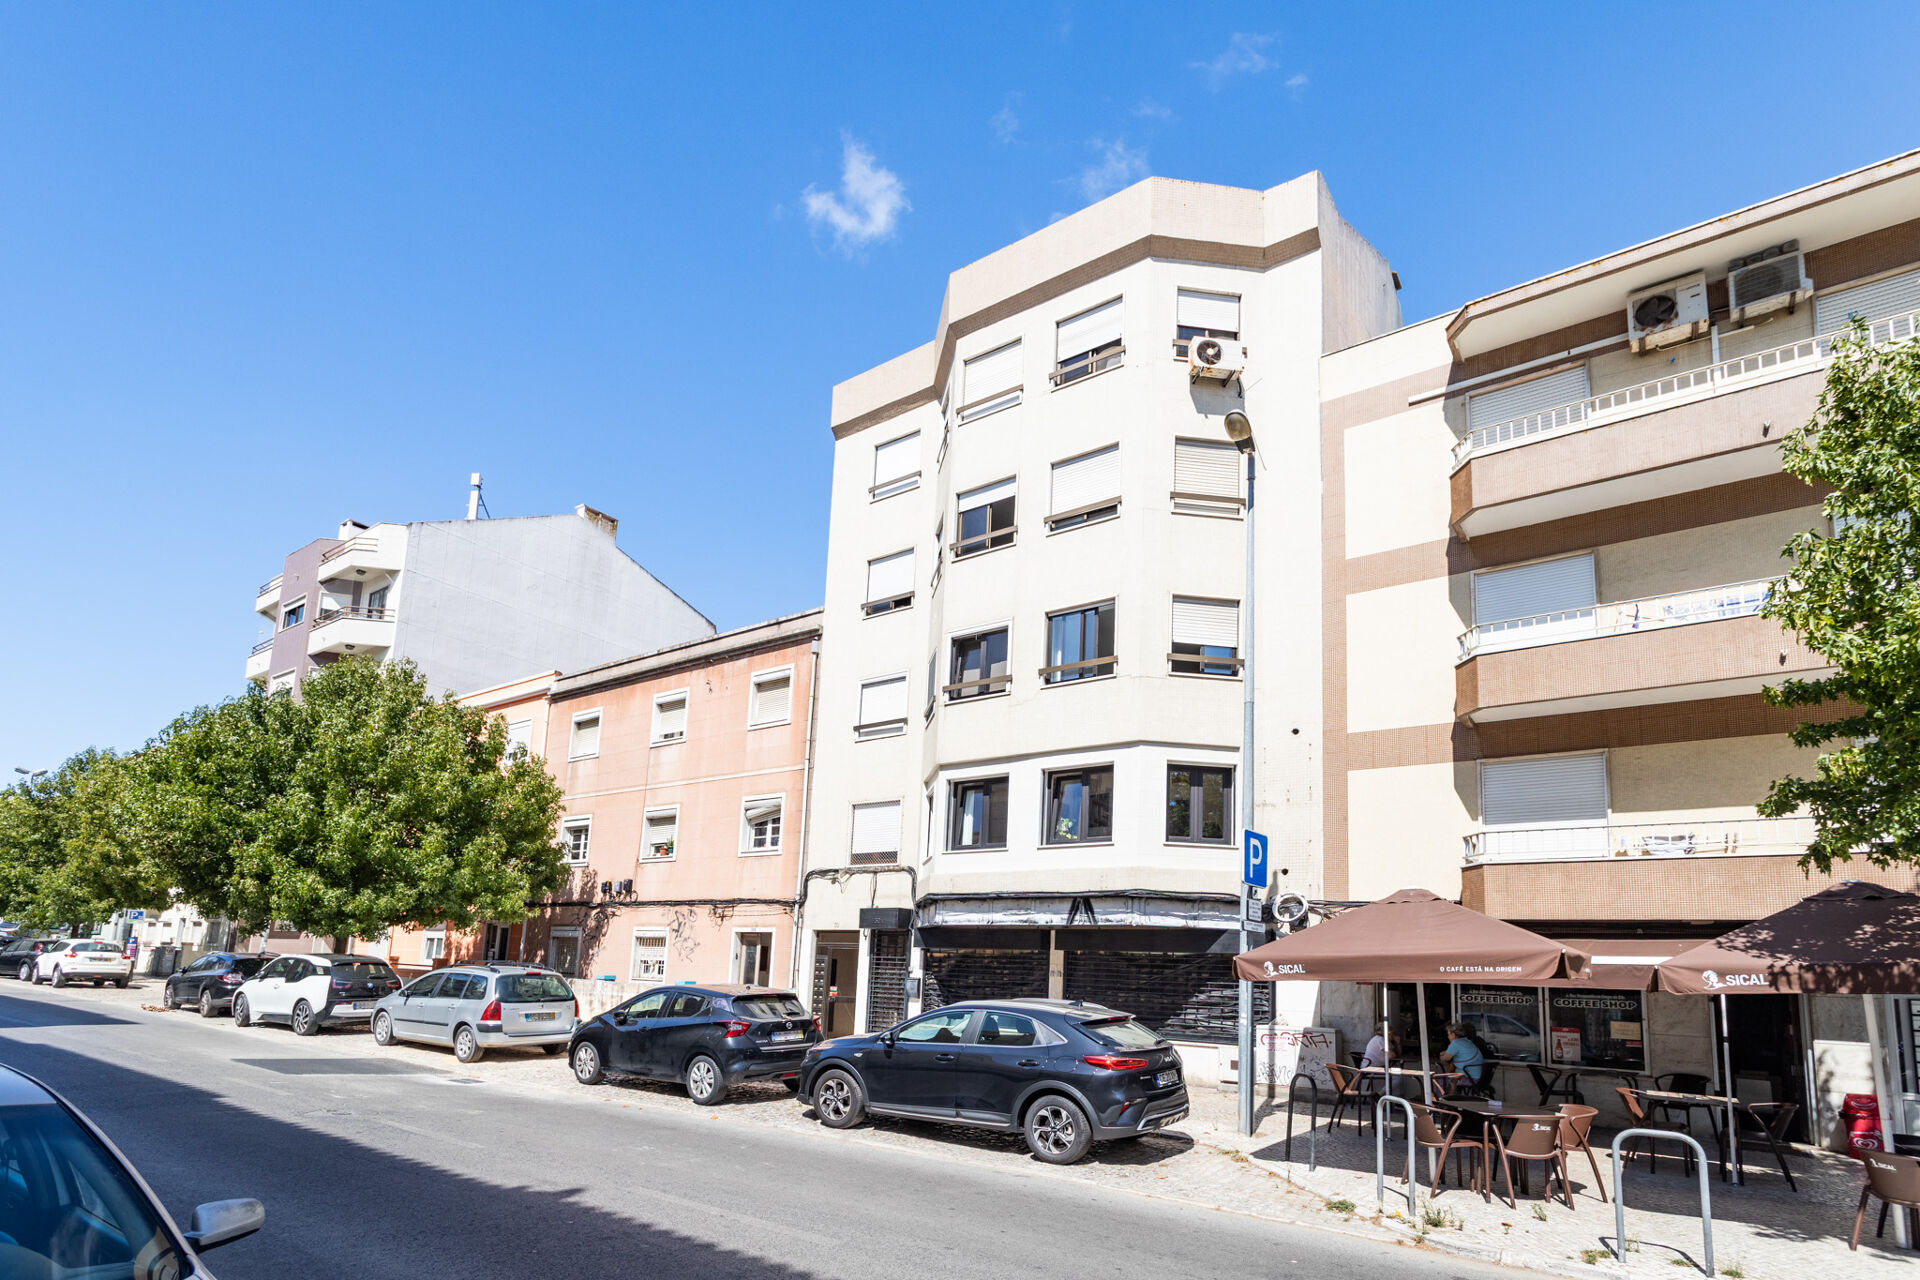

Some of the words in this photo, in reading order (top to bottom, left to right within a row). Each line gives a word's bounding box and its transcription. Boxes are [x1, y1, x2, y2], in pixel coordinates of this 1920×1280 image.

[1250, 837, 1262, 878] P
[1278, 964, 1306, 974] SICAL
[1446, 965, 1464, 973] CAFÉ
[1465, 965, 1482, 973] ESTÁ
[1725, 973, 1770, 986] SICAL
[1459, 994, 1500, 1004] COFFEE
[1501, 995, 1533, 1005] SHOP
[1554, 998, 1601, 1009] COFFEE
[1601, 999, 1637, 1010] SHOP
